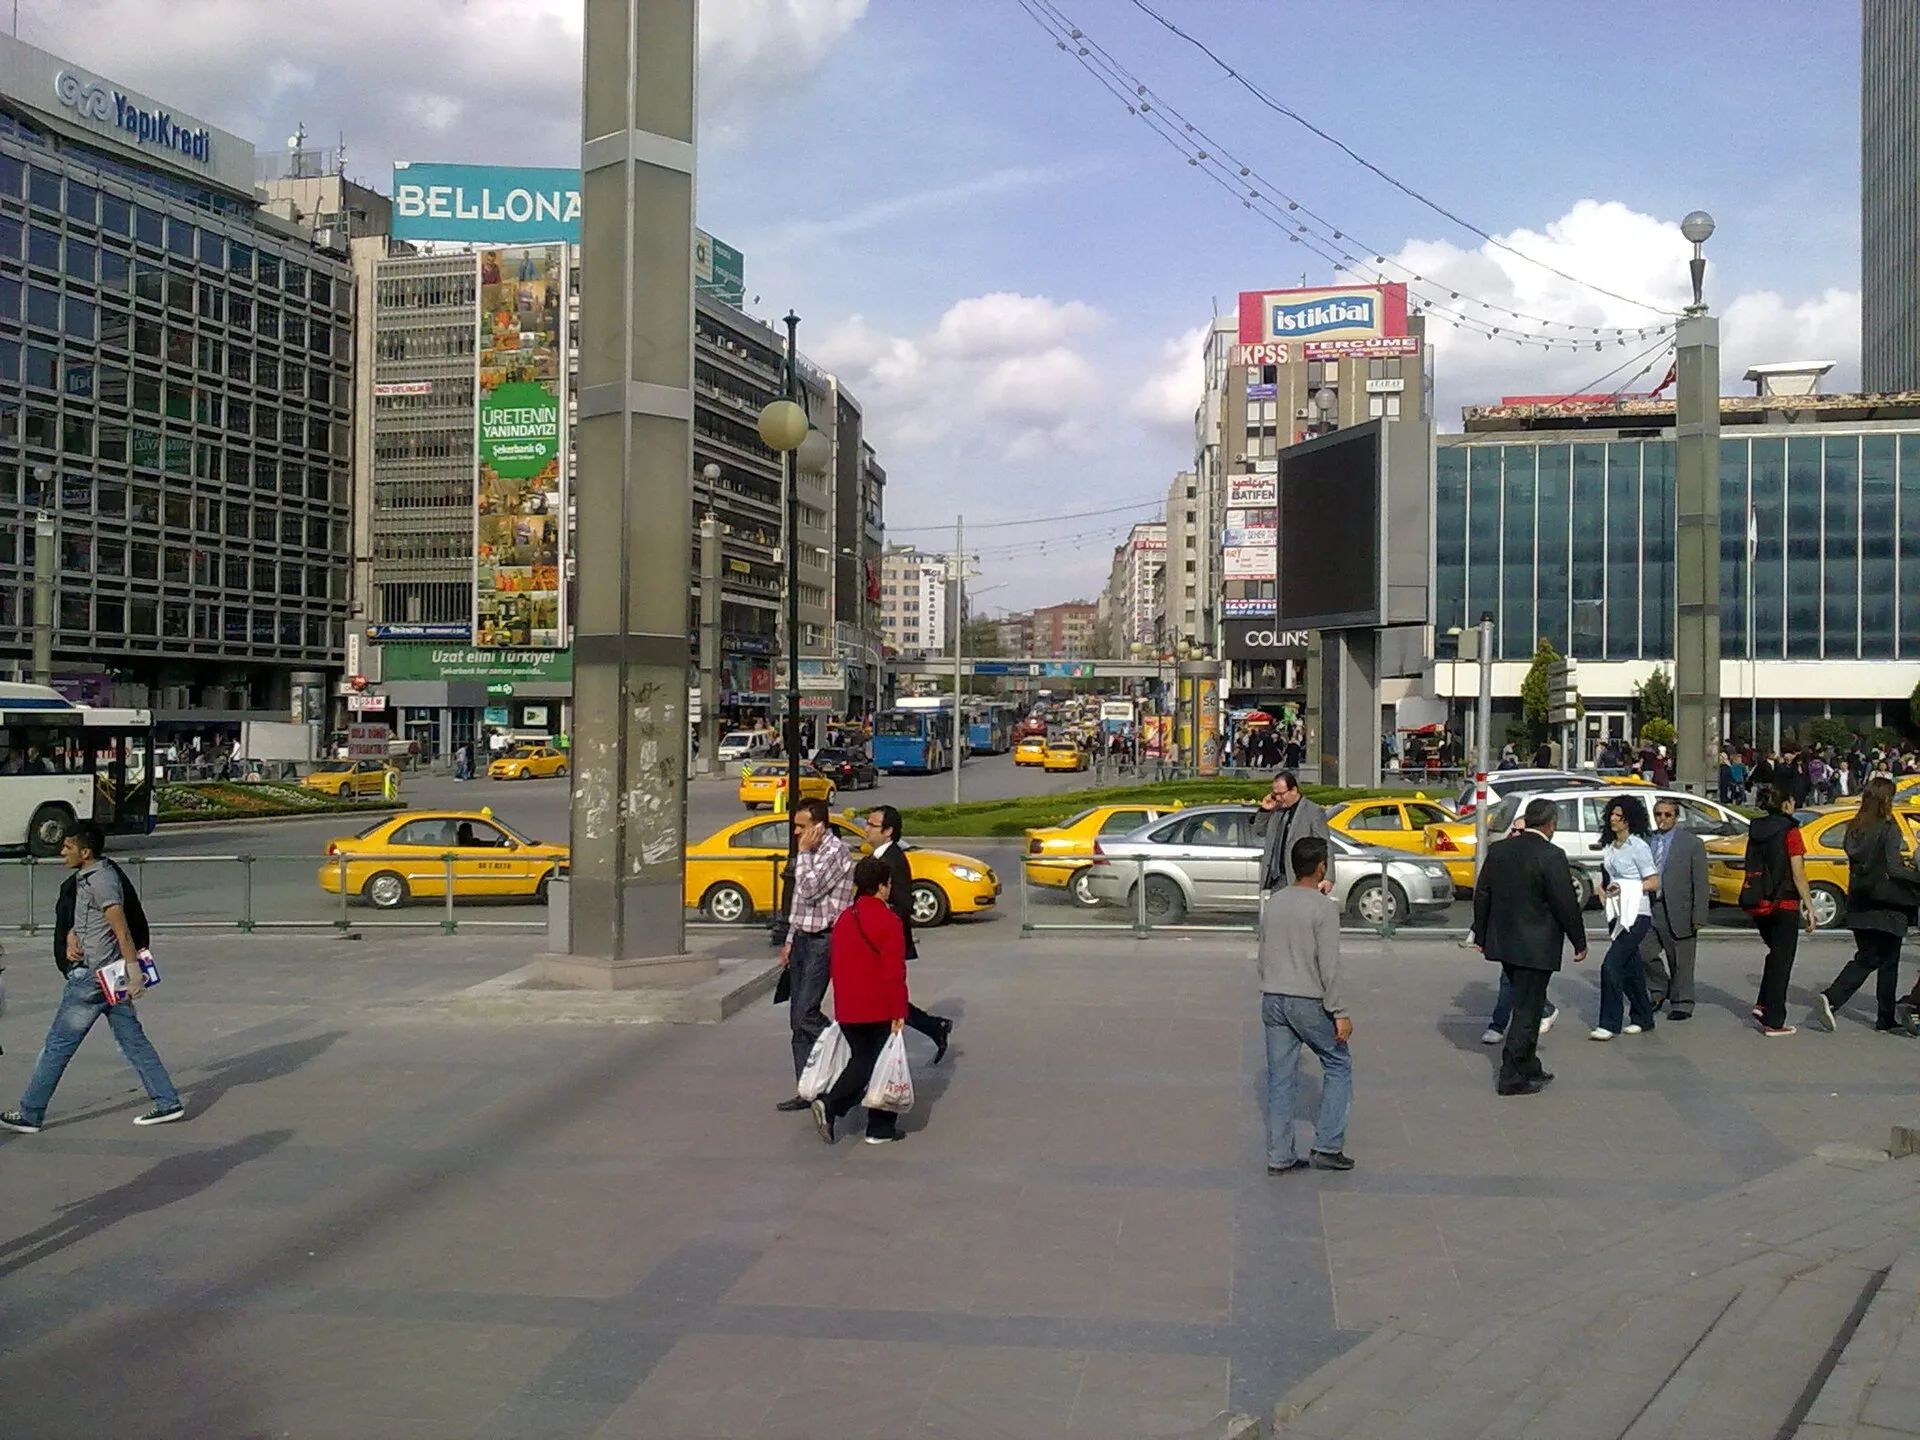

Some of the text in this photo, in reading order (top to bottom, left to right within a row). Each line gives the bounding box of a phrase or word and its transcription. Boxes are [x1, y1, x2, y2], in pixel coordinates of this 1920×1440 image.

[396, 184, 582, 223] BELLONA
[1277, 301, 1370, 331] istikbal
[1240, 344, 1288, 365] KPSS
[482, 404, 556, 425] ÜRETENİN
[1231, 490, 1275, 500] BATIFEN
[1245, 630, 1309, 647] COLIN'S
[432, 650, 556, 666] Uzat elini Türkiye!
